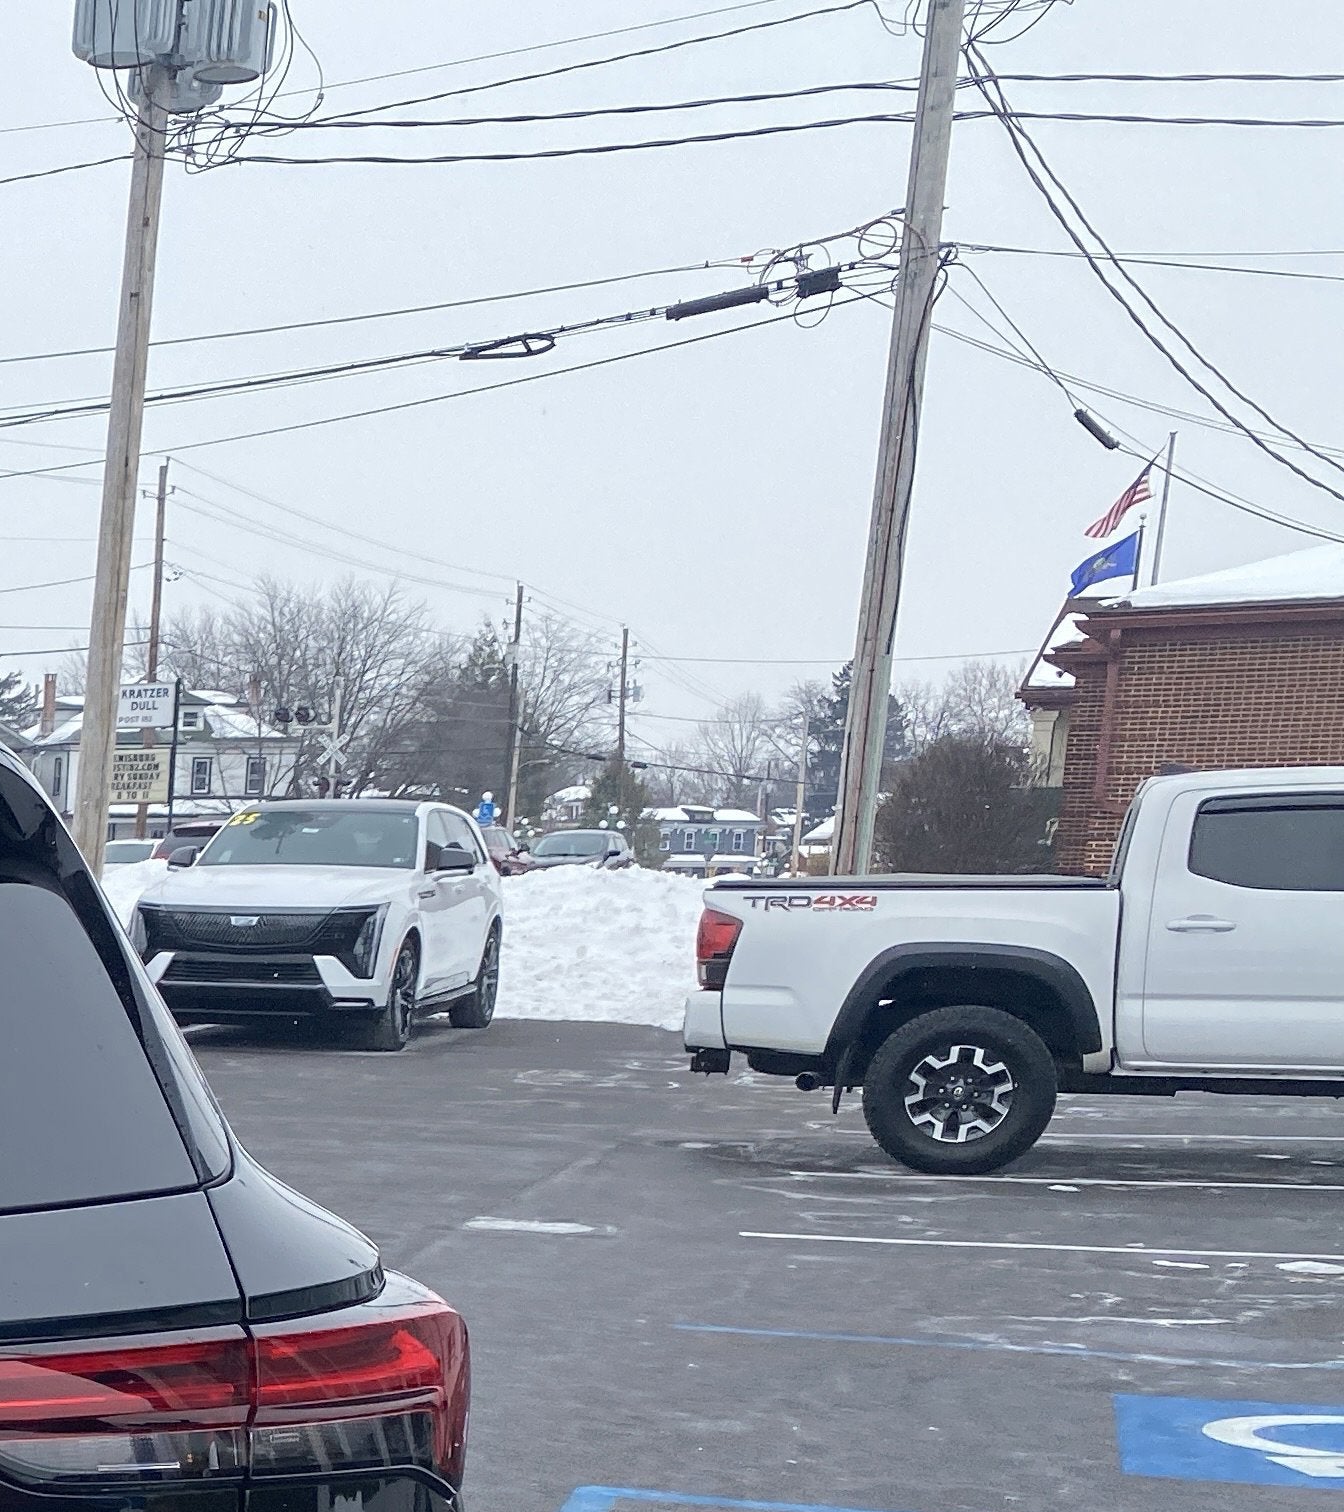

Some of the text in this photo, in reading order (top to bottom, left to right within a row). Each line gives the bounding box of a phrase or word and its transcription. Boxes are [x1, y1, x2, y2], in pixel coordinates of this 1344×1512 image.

[121, 687, 170, 700] KRATZER
[130, 701, 159, 711] DULL
[126, 791, 138, 800] TO
